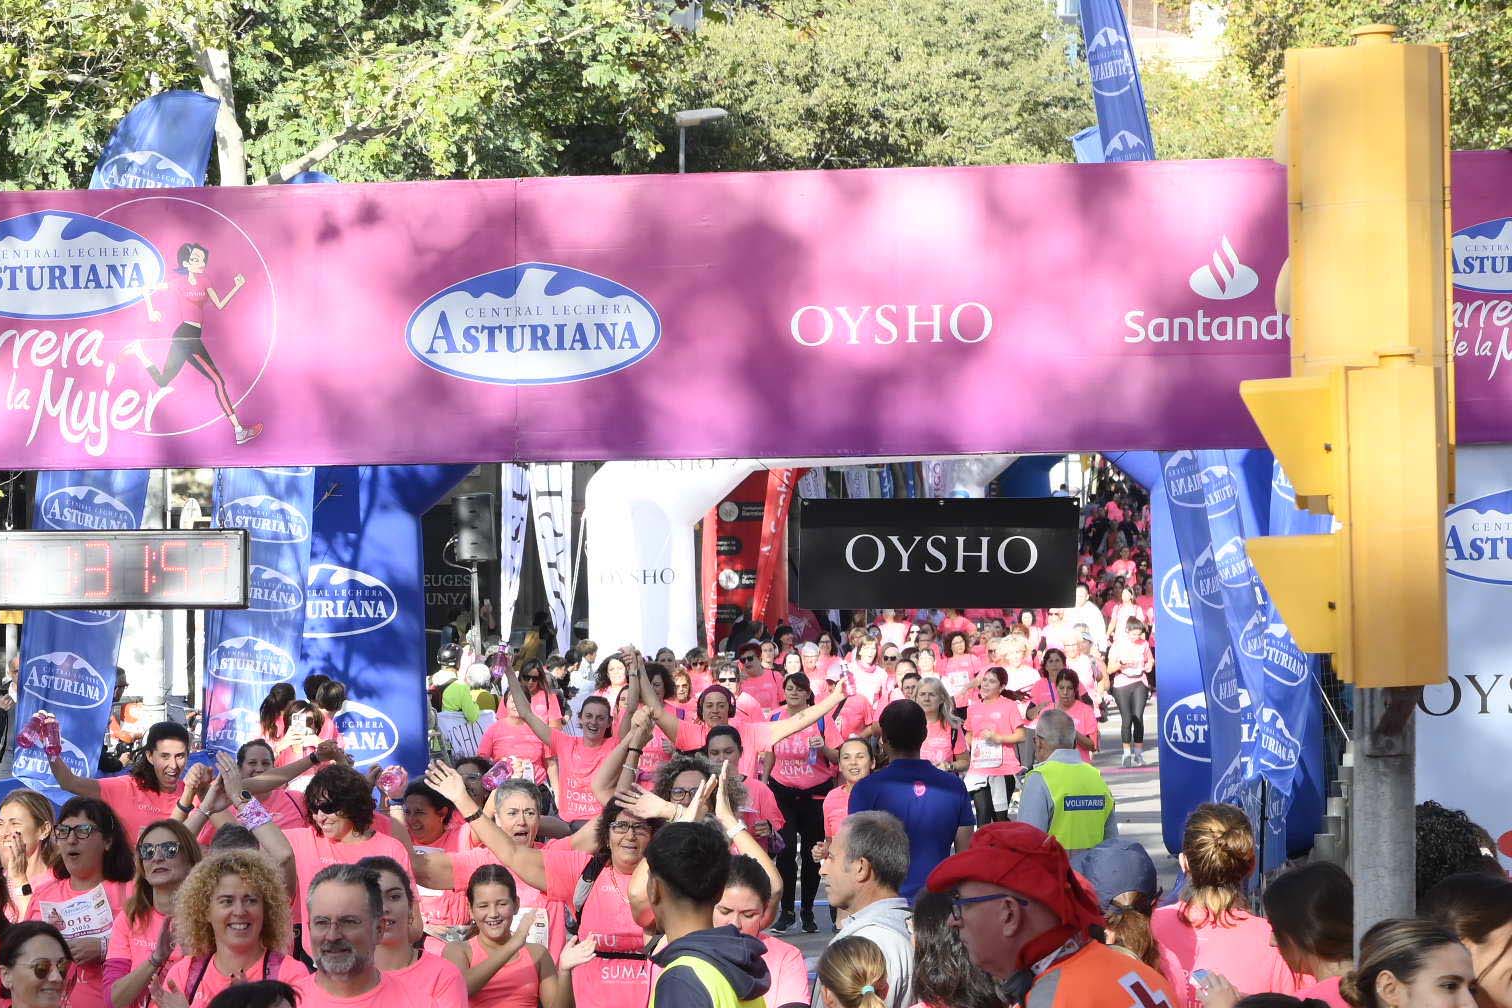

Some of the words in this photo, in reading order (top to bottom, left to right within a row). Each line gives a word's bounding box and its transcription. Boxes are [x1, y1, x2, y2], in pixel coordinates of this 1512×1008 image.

[67, 247, 140, 259] LECHERA
[463, 305, 546, 319] CENTRAL
[551, 303, 634, 317] LECHERA
[791, 302, 993, 346] OYSHO
[425, 308, 642, 356] ASTURIANA
[1123, 310, 1292, 343] Santand
[6, 371, 31, 410] la
[25, 361, 176, 457] Mujer
[845, 534, 1039, 575] OYSHO
[334, 588, 384, 597] LECHERA
[306, 599, 388, 620] URIANA
[25, 668, 100, 702] ASTURIANA
[67, 914, 92, 928] 016
[601, 964, 648, 979] SUMA
